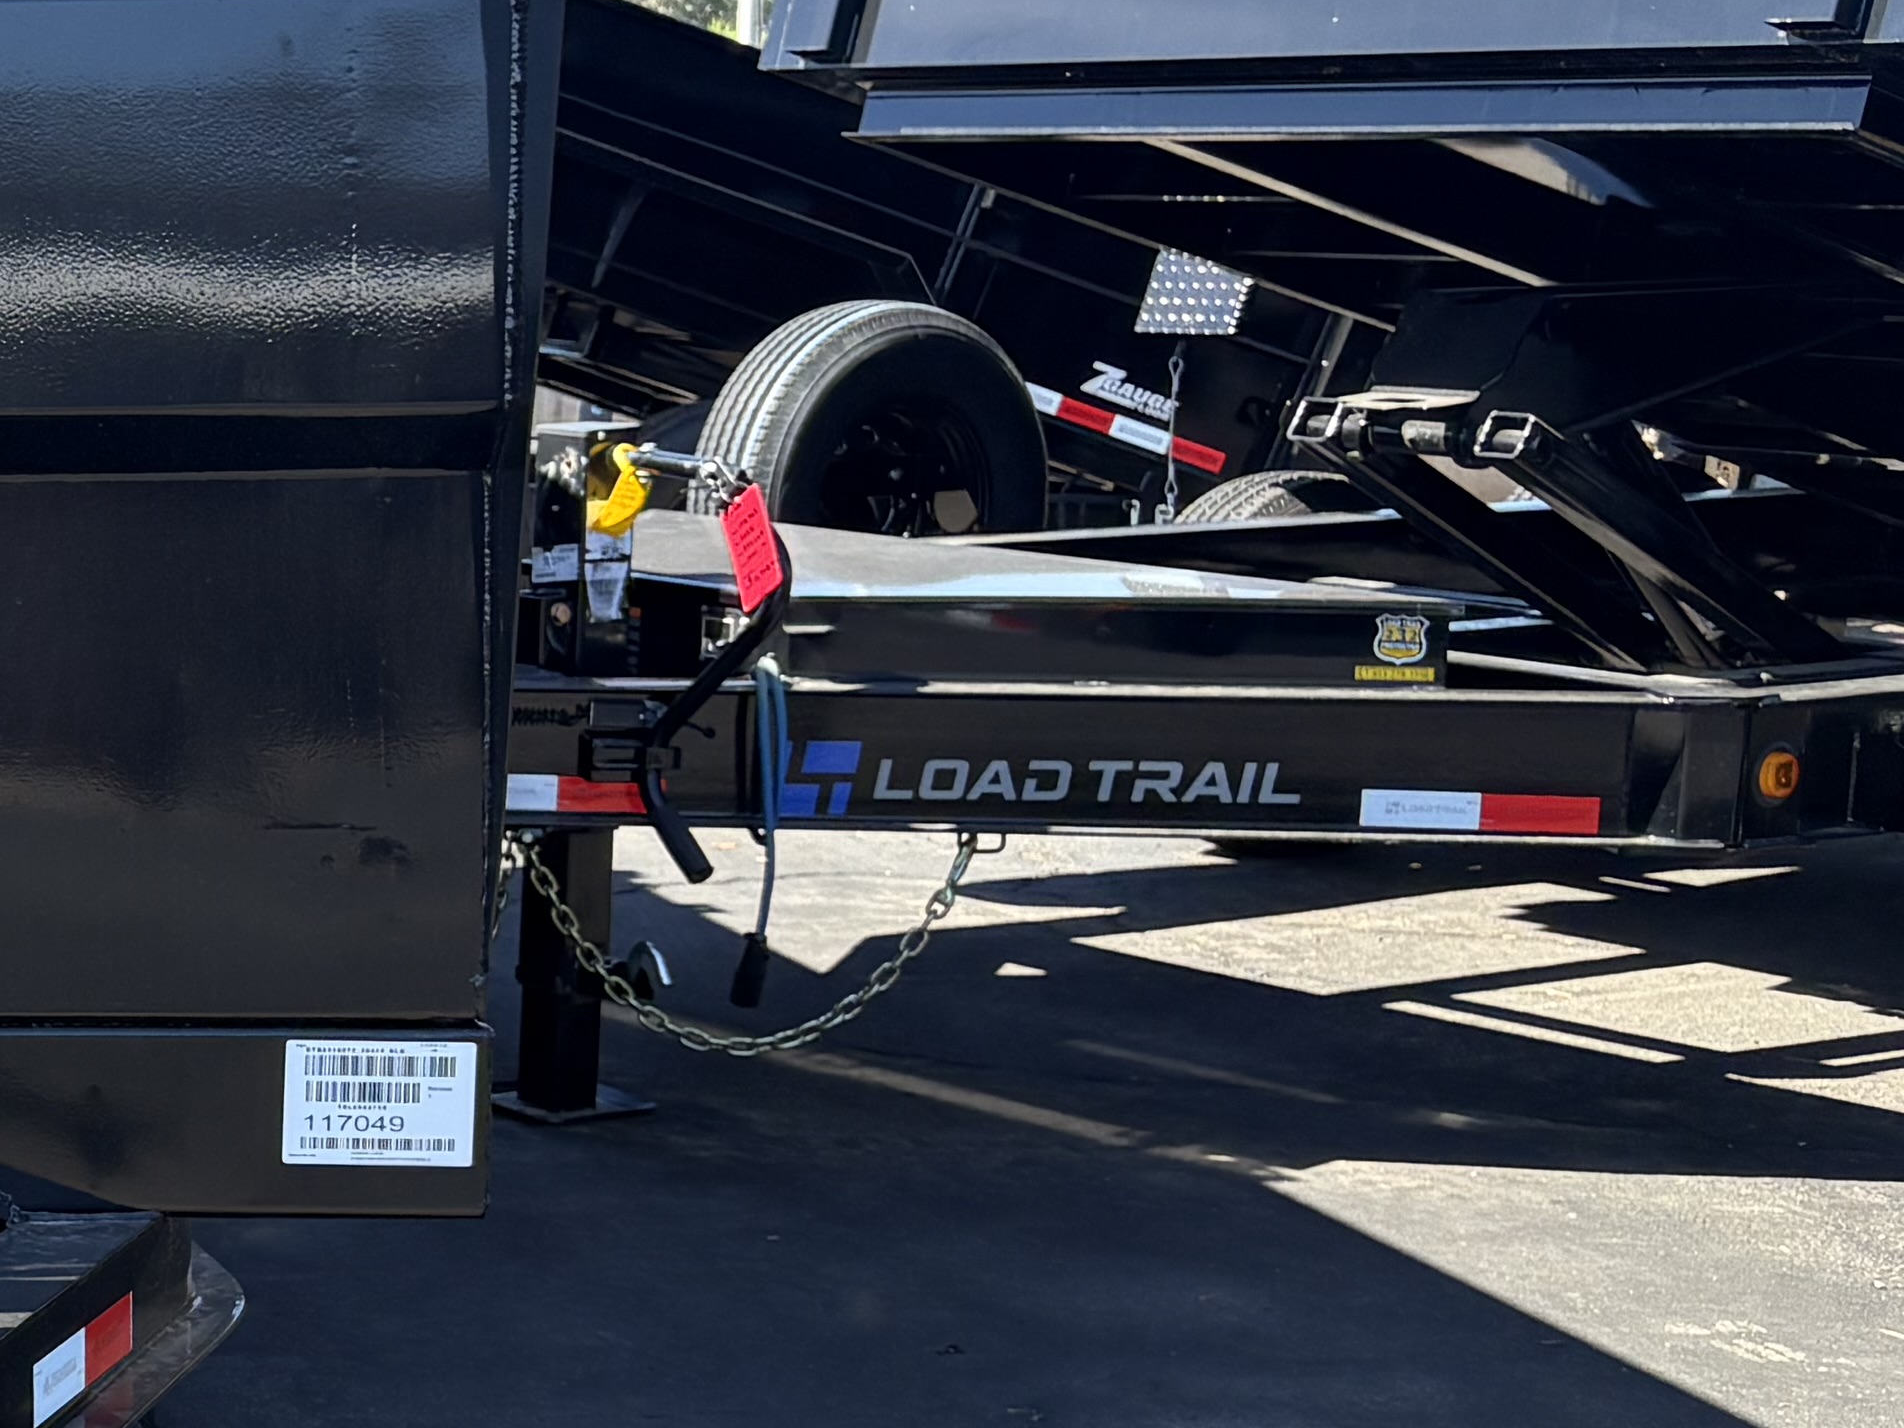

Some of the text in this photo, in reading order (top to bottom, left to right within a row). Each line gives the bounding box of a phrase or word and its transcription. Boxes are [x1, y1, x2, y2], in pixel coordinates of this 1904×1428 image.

[873, 758, 1301, 805] LOAD TRAIL
[304, 1114, 405, 1132] 117049
